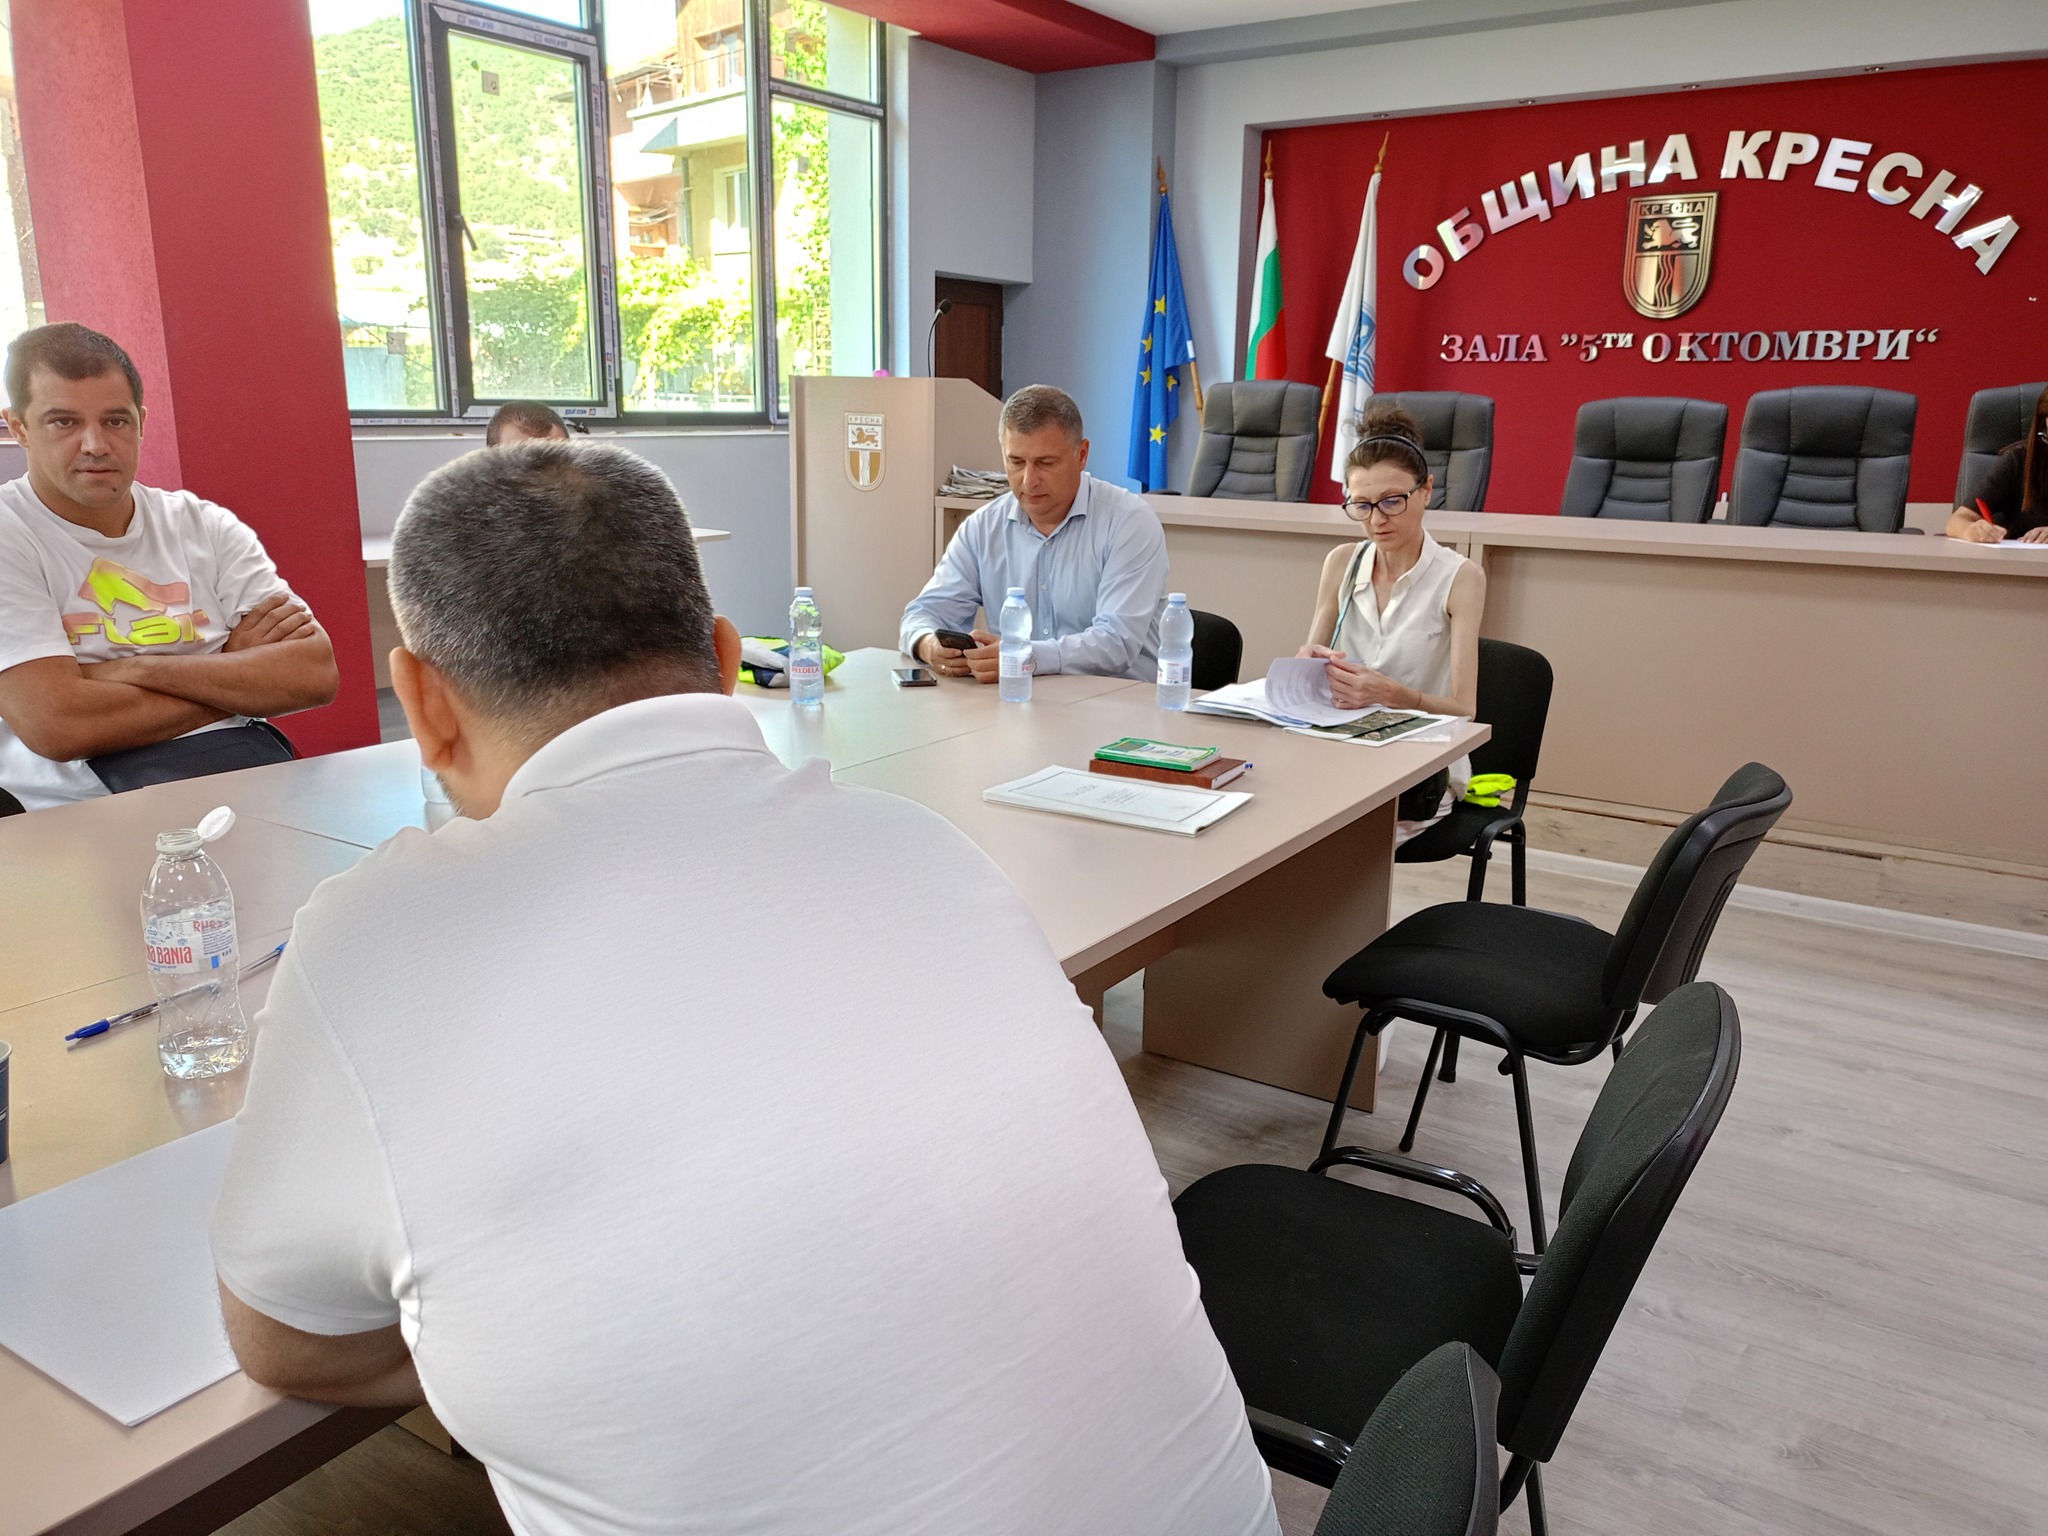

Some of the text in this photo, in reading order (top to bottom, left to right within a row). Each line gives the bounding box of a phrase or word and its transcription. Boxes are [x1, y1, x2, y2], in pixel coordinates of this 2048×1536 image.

[1402, 129, 2020, 291] ОБЩИНА КРЕСНА
[1641, 202, 1704, 215] КРЕСНА
[1440, 334, 1548, 362] ЗАЛА
[849, 416, 881, 424] КРЕСНА
